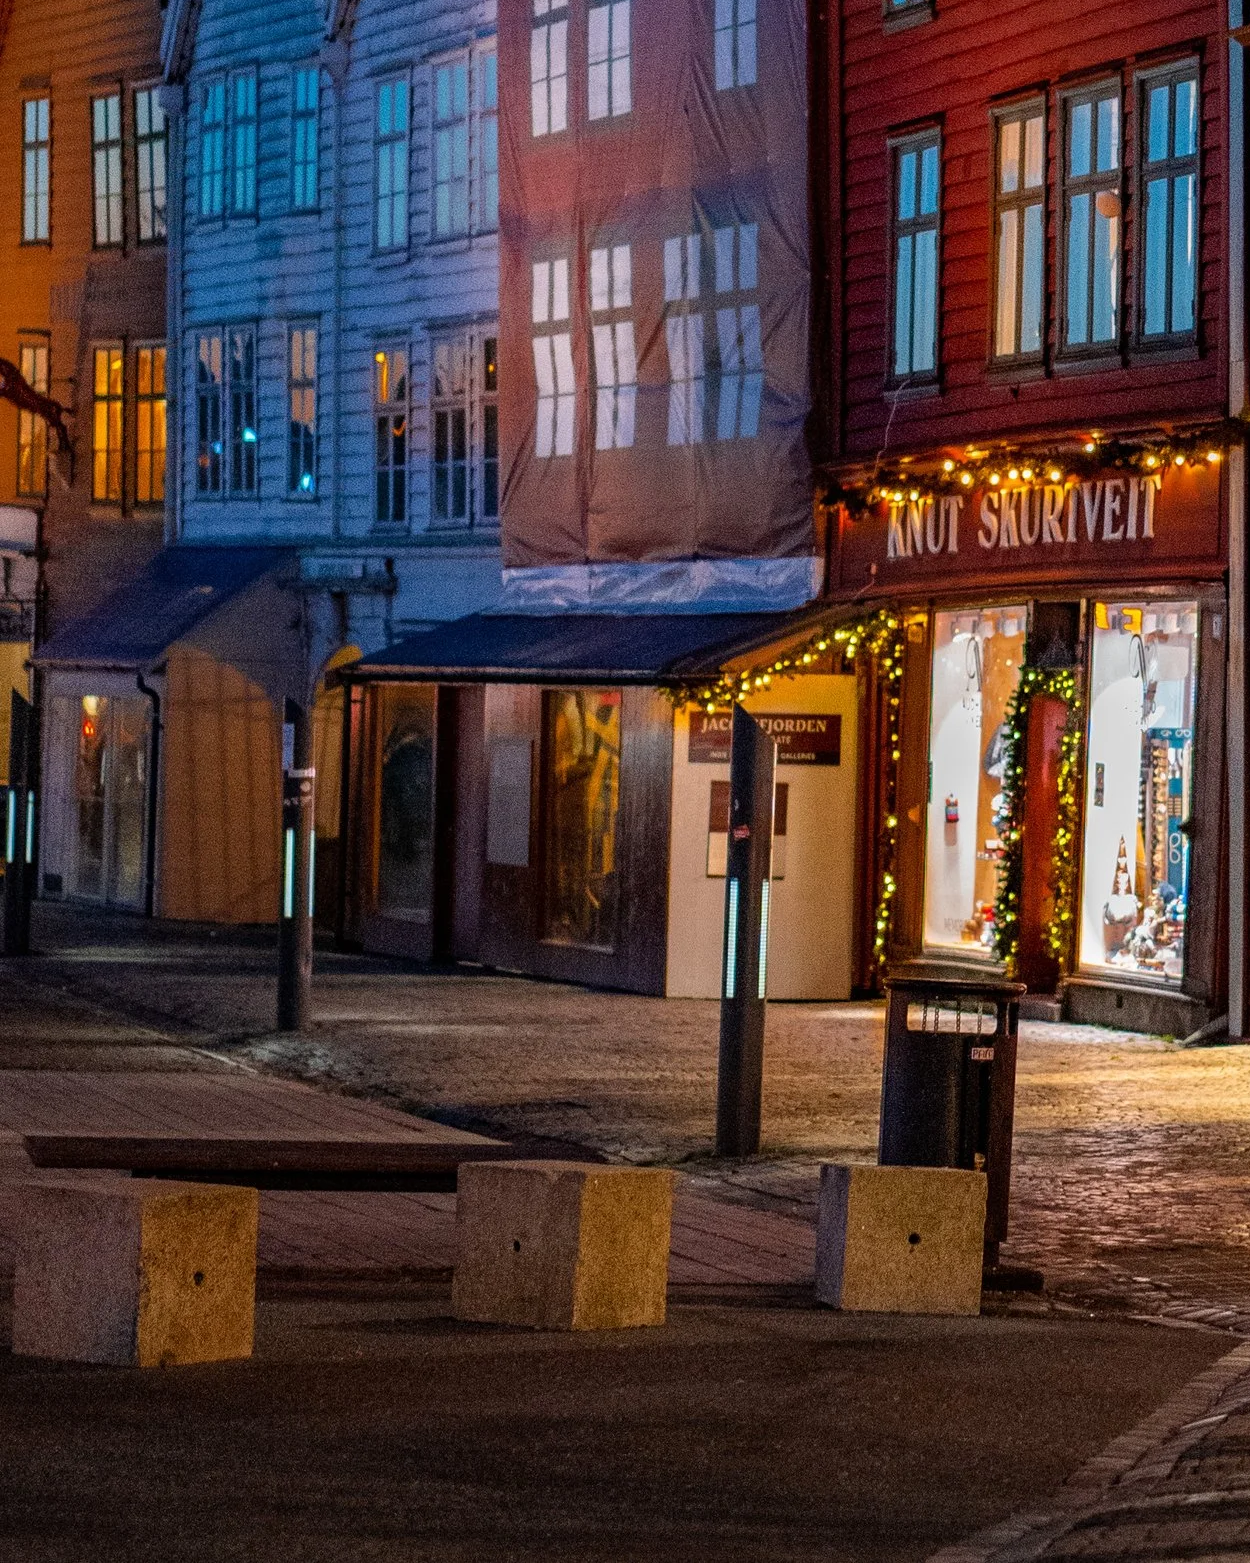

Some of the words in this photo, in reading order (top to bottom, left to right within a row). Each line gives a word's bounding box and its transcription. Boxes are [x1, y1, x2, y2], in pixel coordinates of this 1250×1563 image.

[887, 495, 963, 558] KNUT
[978, 474, 1162, 550] SKURTVEIT
[701, 718, 827, 734] JACFJORDEN
